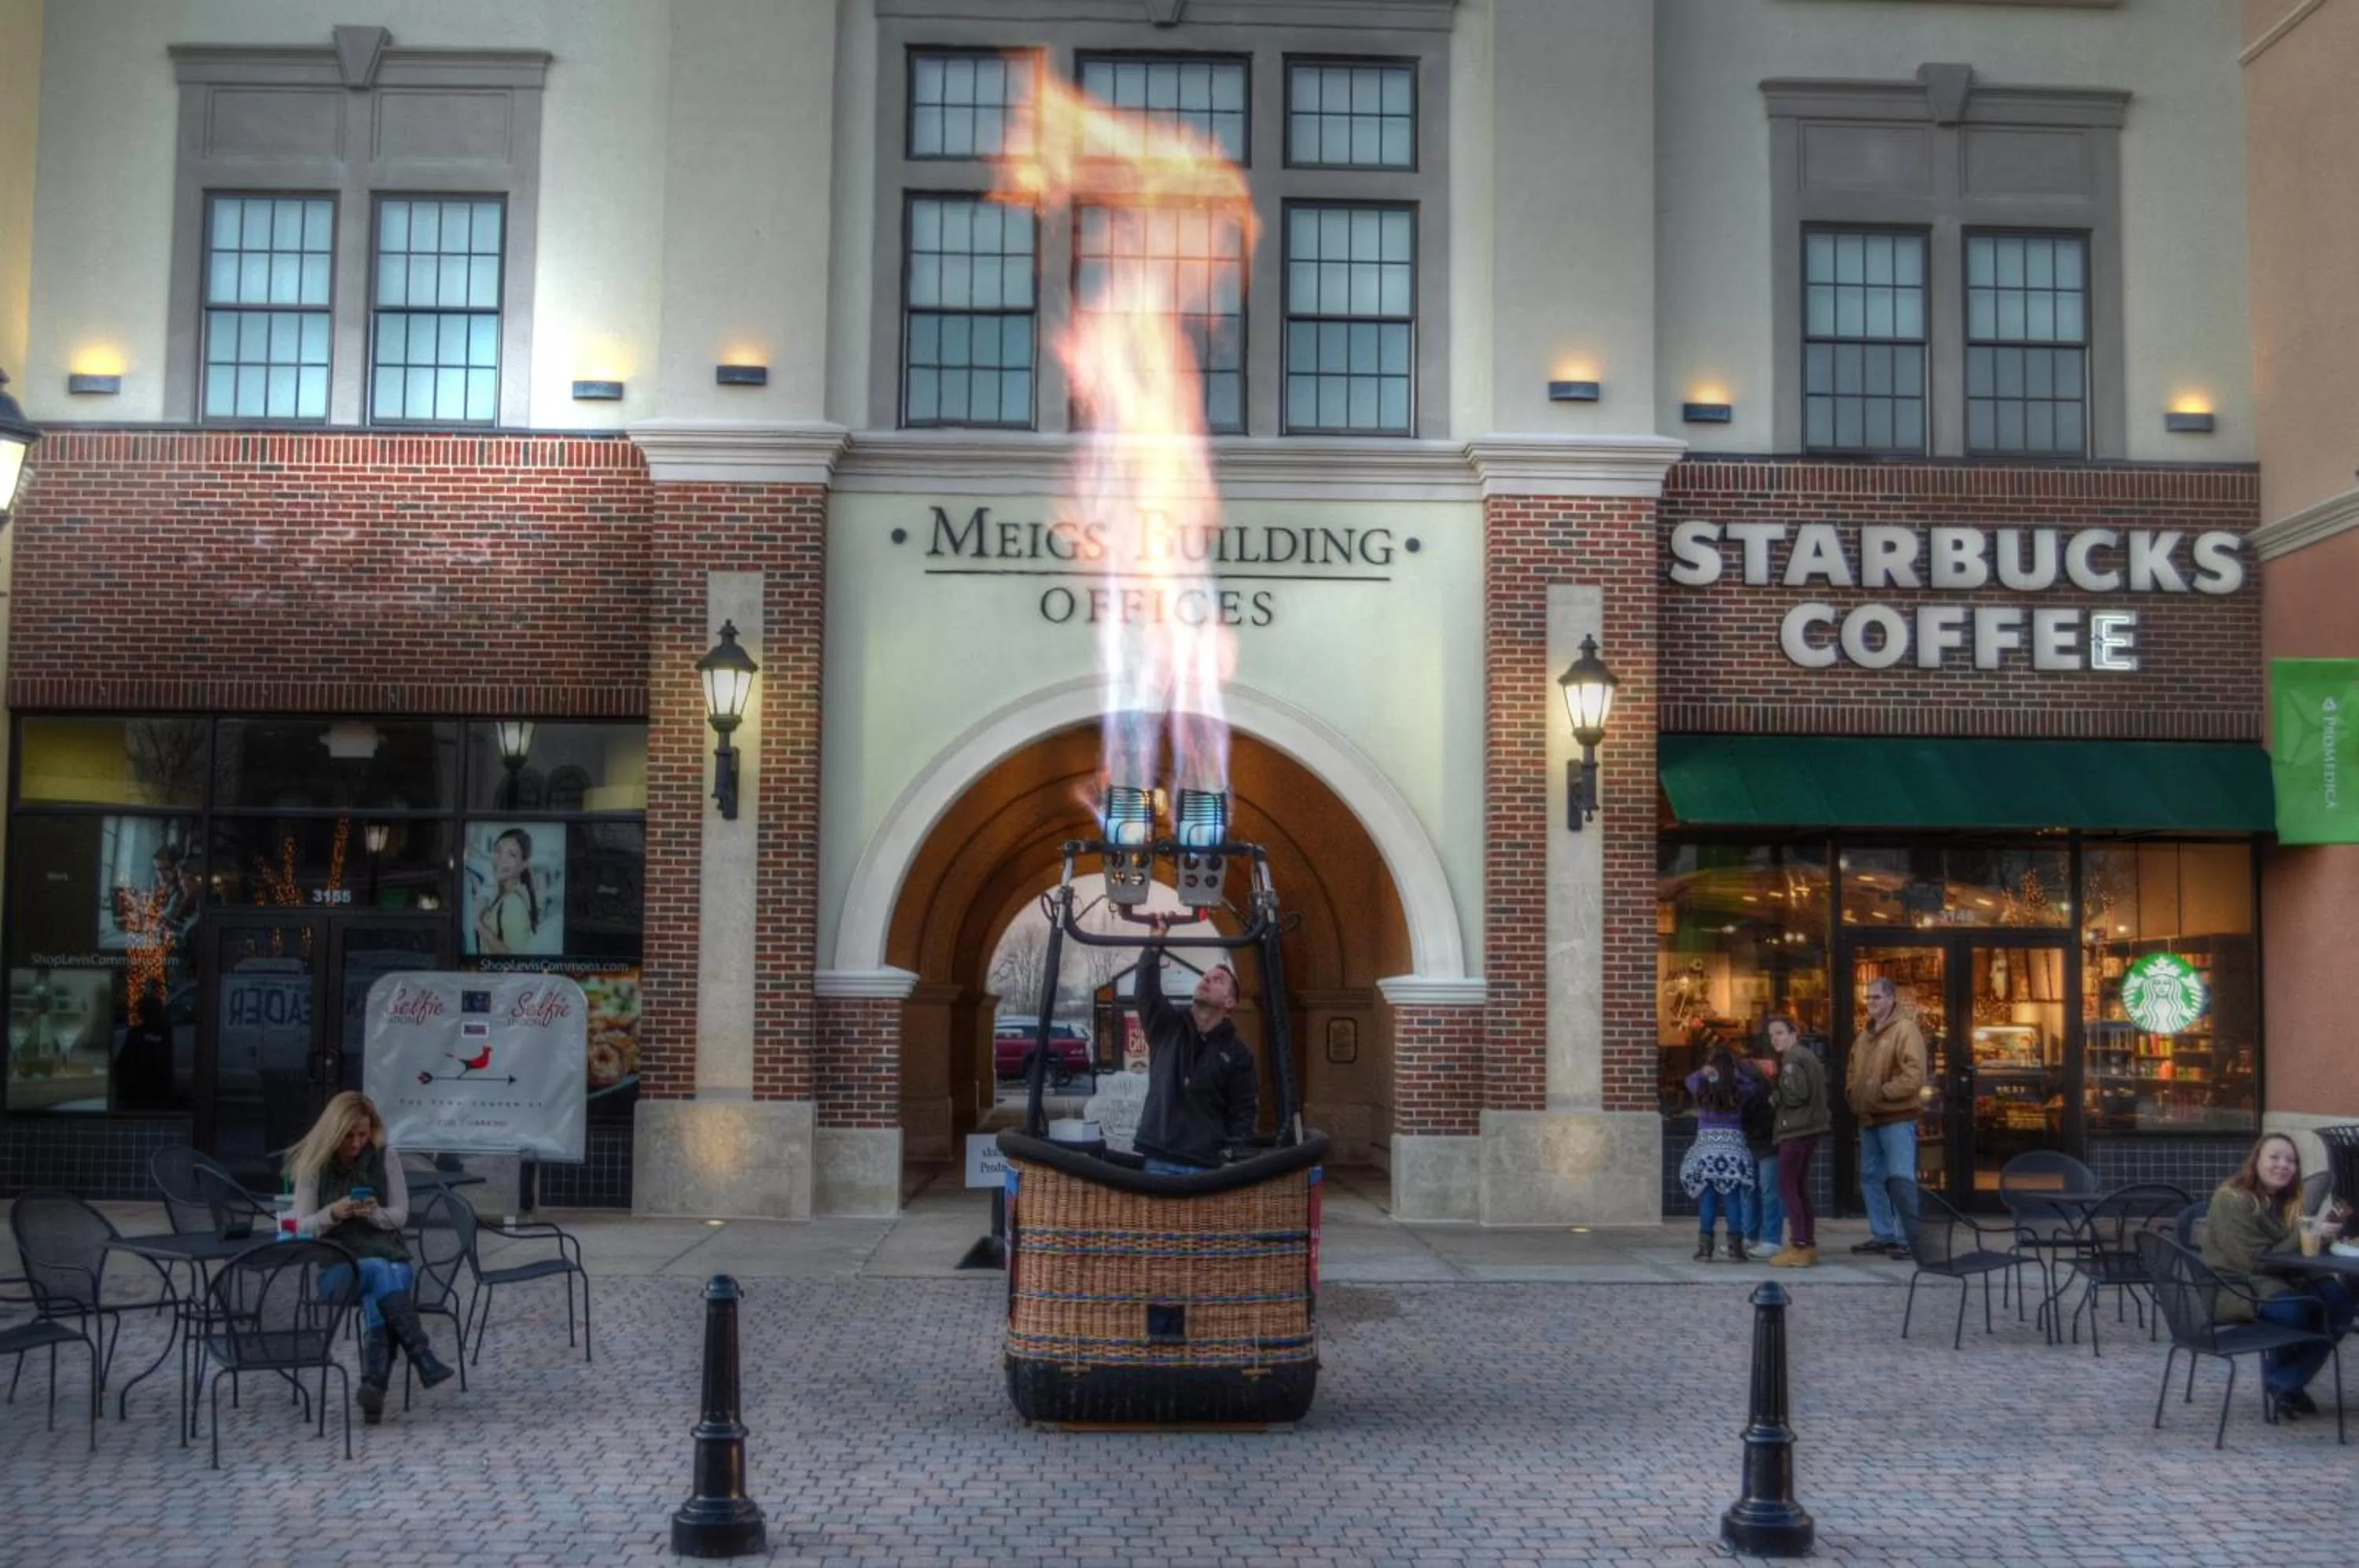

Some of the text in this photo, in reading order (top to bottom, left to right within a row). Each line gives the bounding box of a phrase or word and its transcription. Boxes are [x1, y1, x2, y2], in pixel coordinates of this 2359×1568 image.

[926, 506, 1110, 561] MEIGS
[1669, 521, 2246, 595] STARBUCKS
[1040, 586, 1275, 628] OFFICES
[1779, 602, 2138, 672] COFFEE
[478, 958, 629, 972] ShopLevisCommons.com
